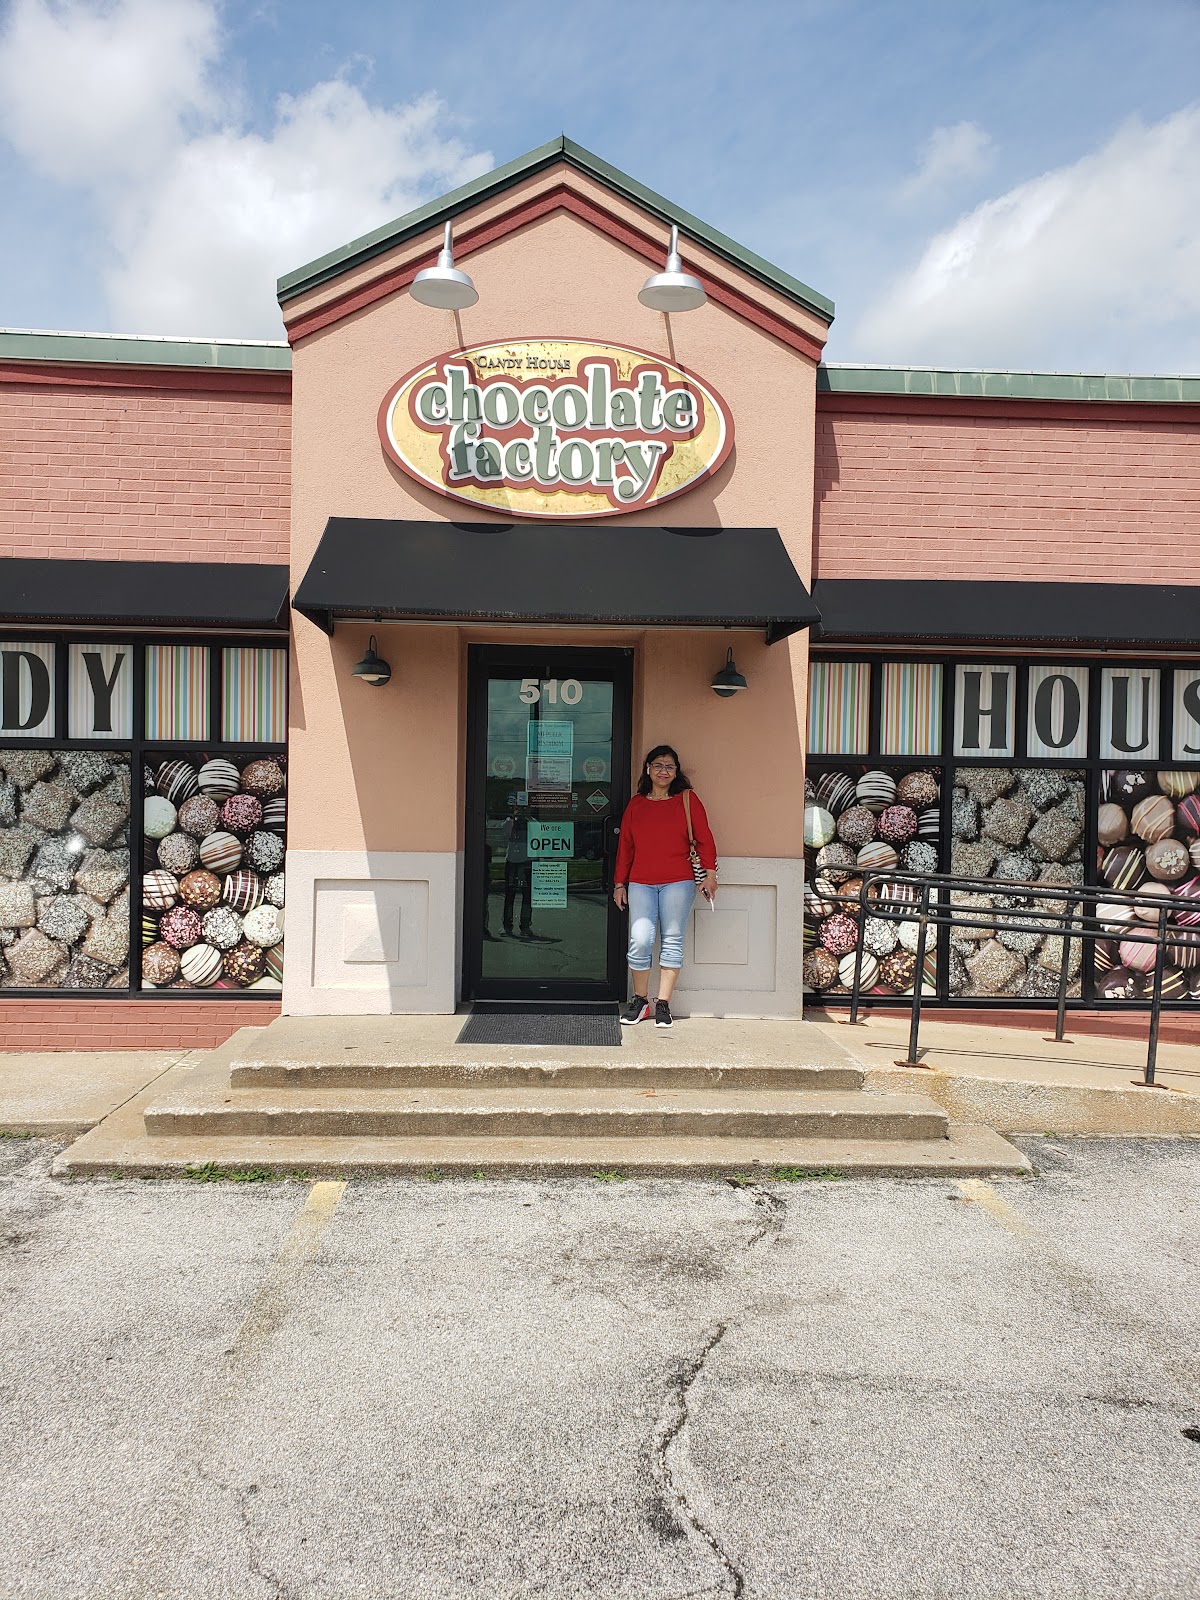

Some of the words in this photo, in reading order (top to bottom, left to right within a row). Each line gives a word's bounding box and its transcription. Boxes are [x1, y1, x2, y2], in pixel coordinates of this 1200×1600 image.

[420, 367, 693, 431] chocolate
[451, 421, 662, 498] factory
[519, 679, 583, 705] 510
[530, 838, 571, 851] OPEN
